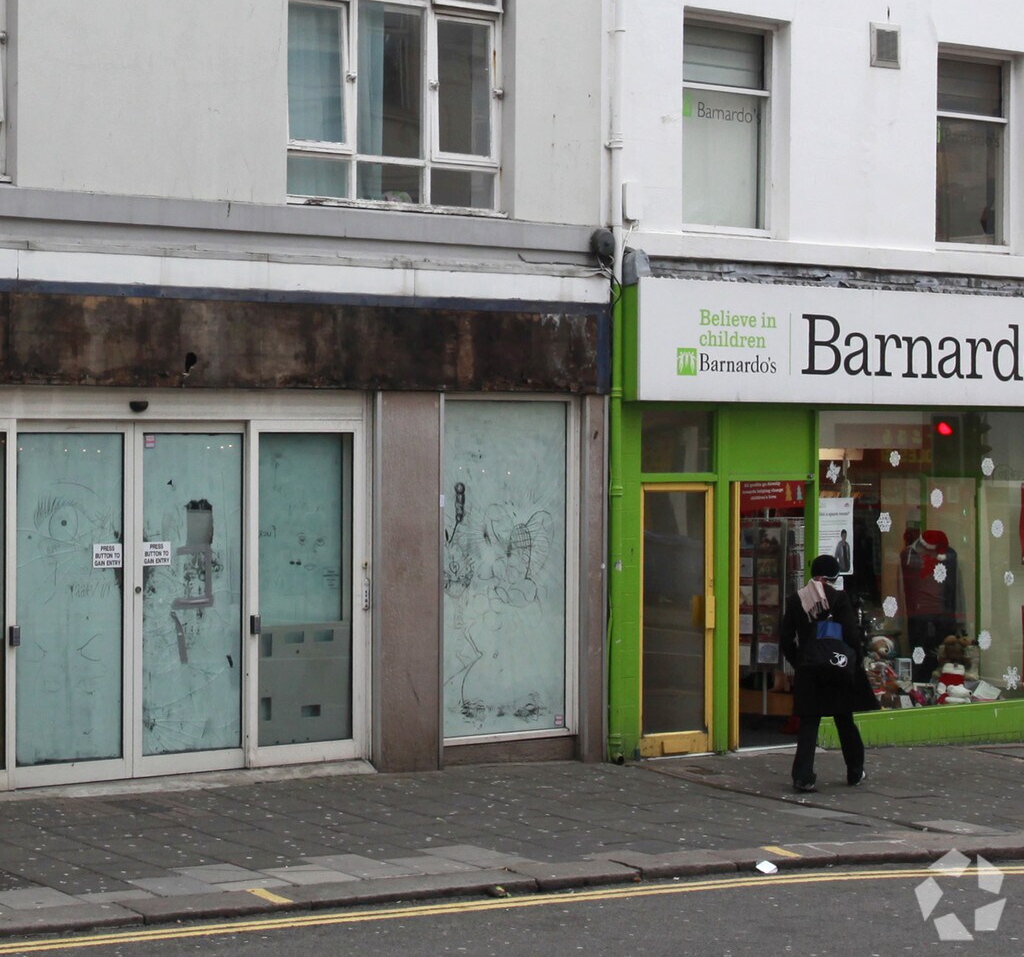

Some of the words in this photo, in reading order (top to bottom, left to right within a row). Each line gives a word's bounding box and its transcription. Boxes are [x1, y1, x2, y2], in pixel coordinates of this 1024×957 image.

[697, 101, 762, 124] Barnardo's
[699, 308, 757, 328] Believe
[760, 311, 777, 329] in
[699, 330, 767, 349] children
[801, 313, 1024, 382] Barnard
[699, 352, 777, 374] Barnardo's
